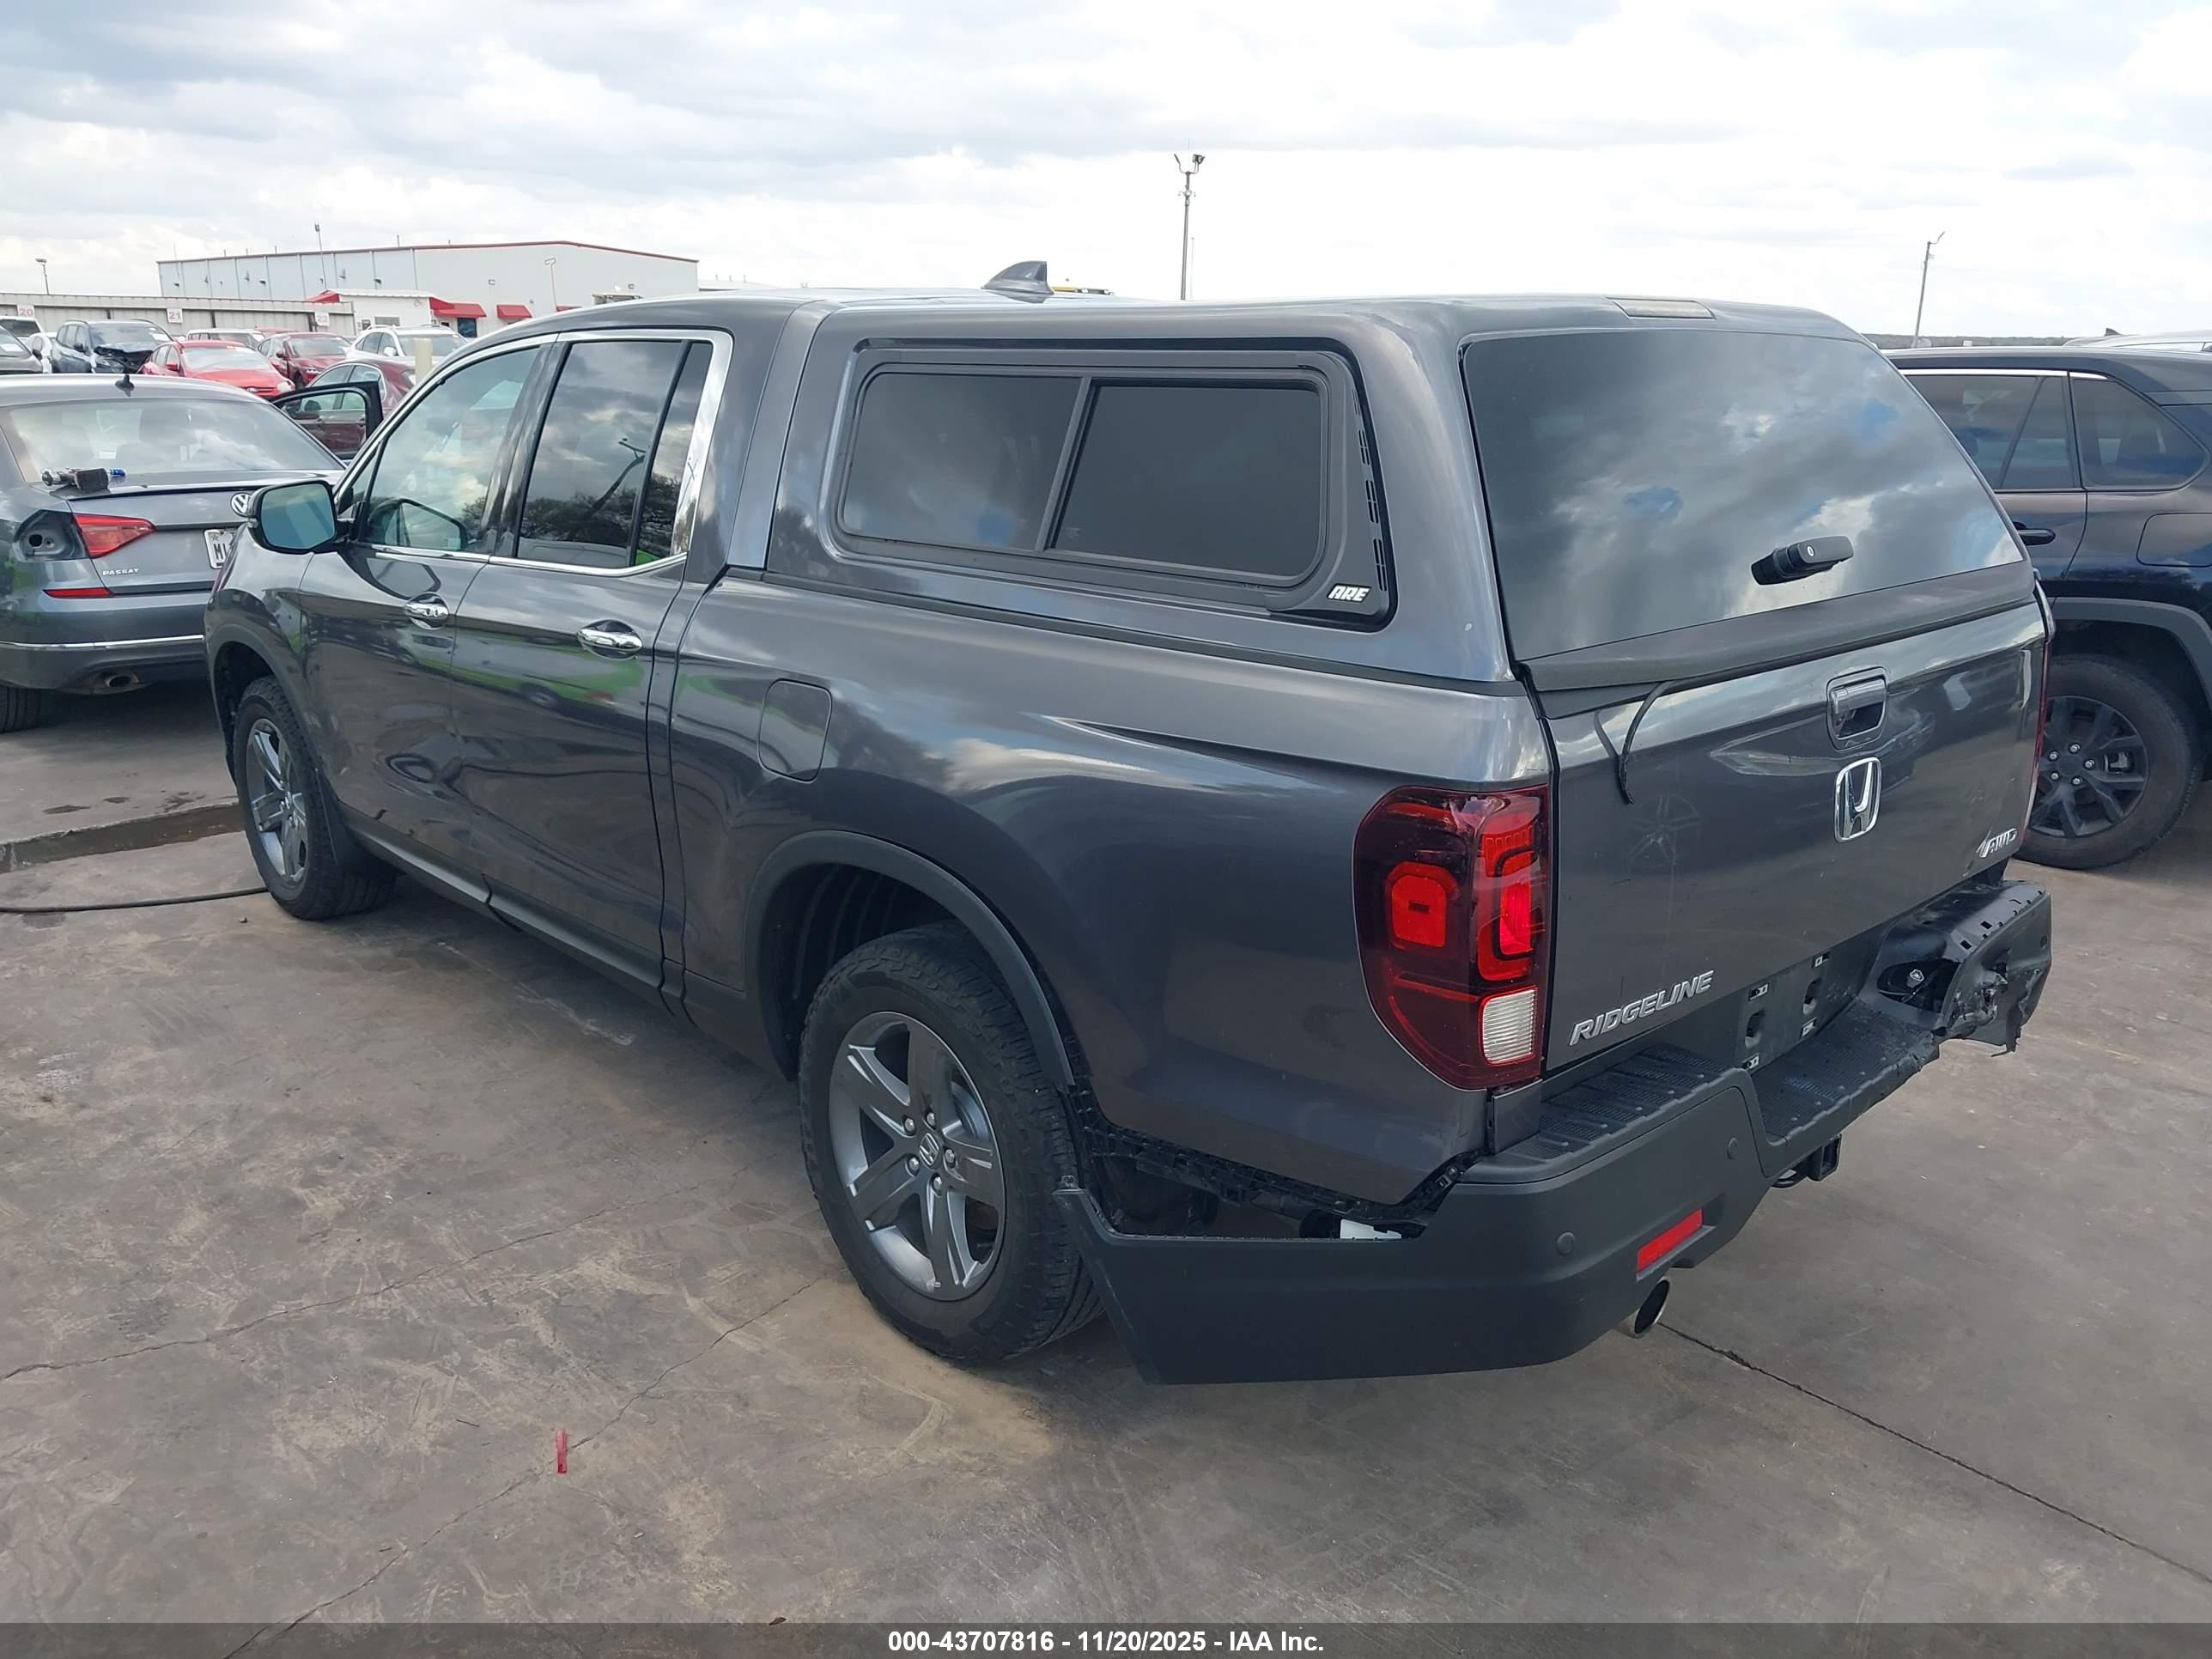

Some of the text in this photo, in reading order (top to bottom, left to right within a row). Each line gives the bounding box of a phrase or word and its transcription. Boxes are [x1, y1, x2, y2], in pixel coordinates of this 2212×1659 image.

[19, 308, 33, 317] 20
[168, 311, 180, 319] 21
[102, 568, 139, 576] PASSAT
[1328, 585, 1370, 602] ARE
[1569, 969, 1714, 1046] RIDGELINE
